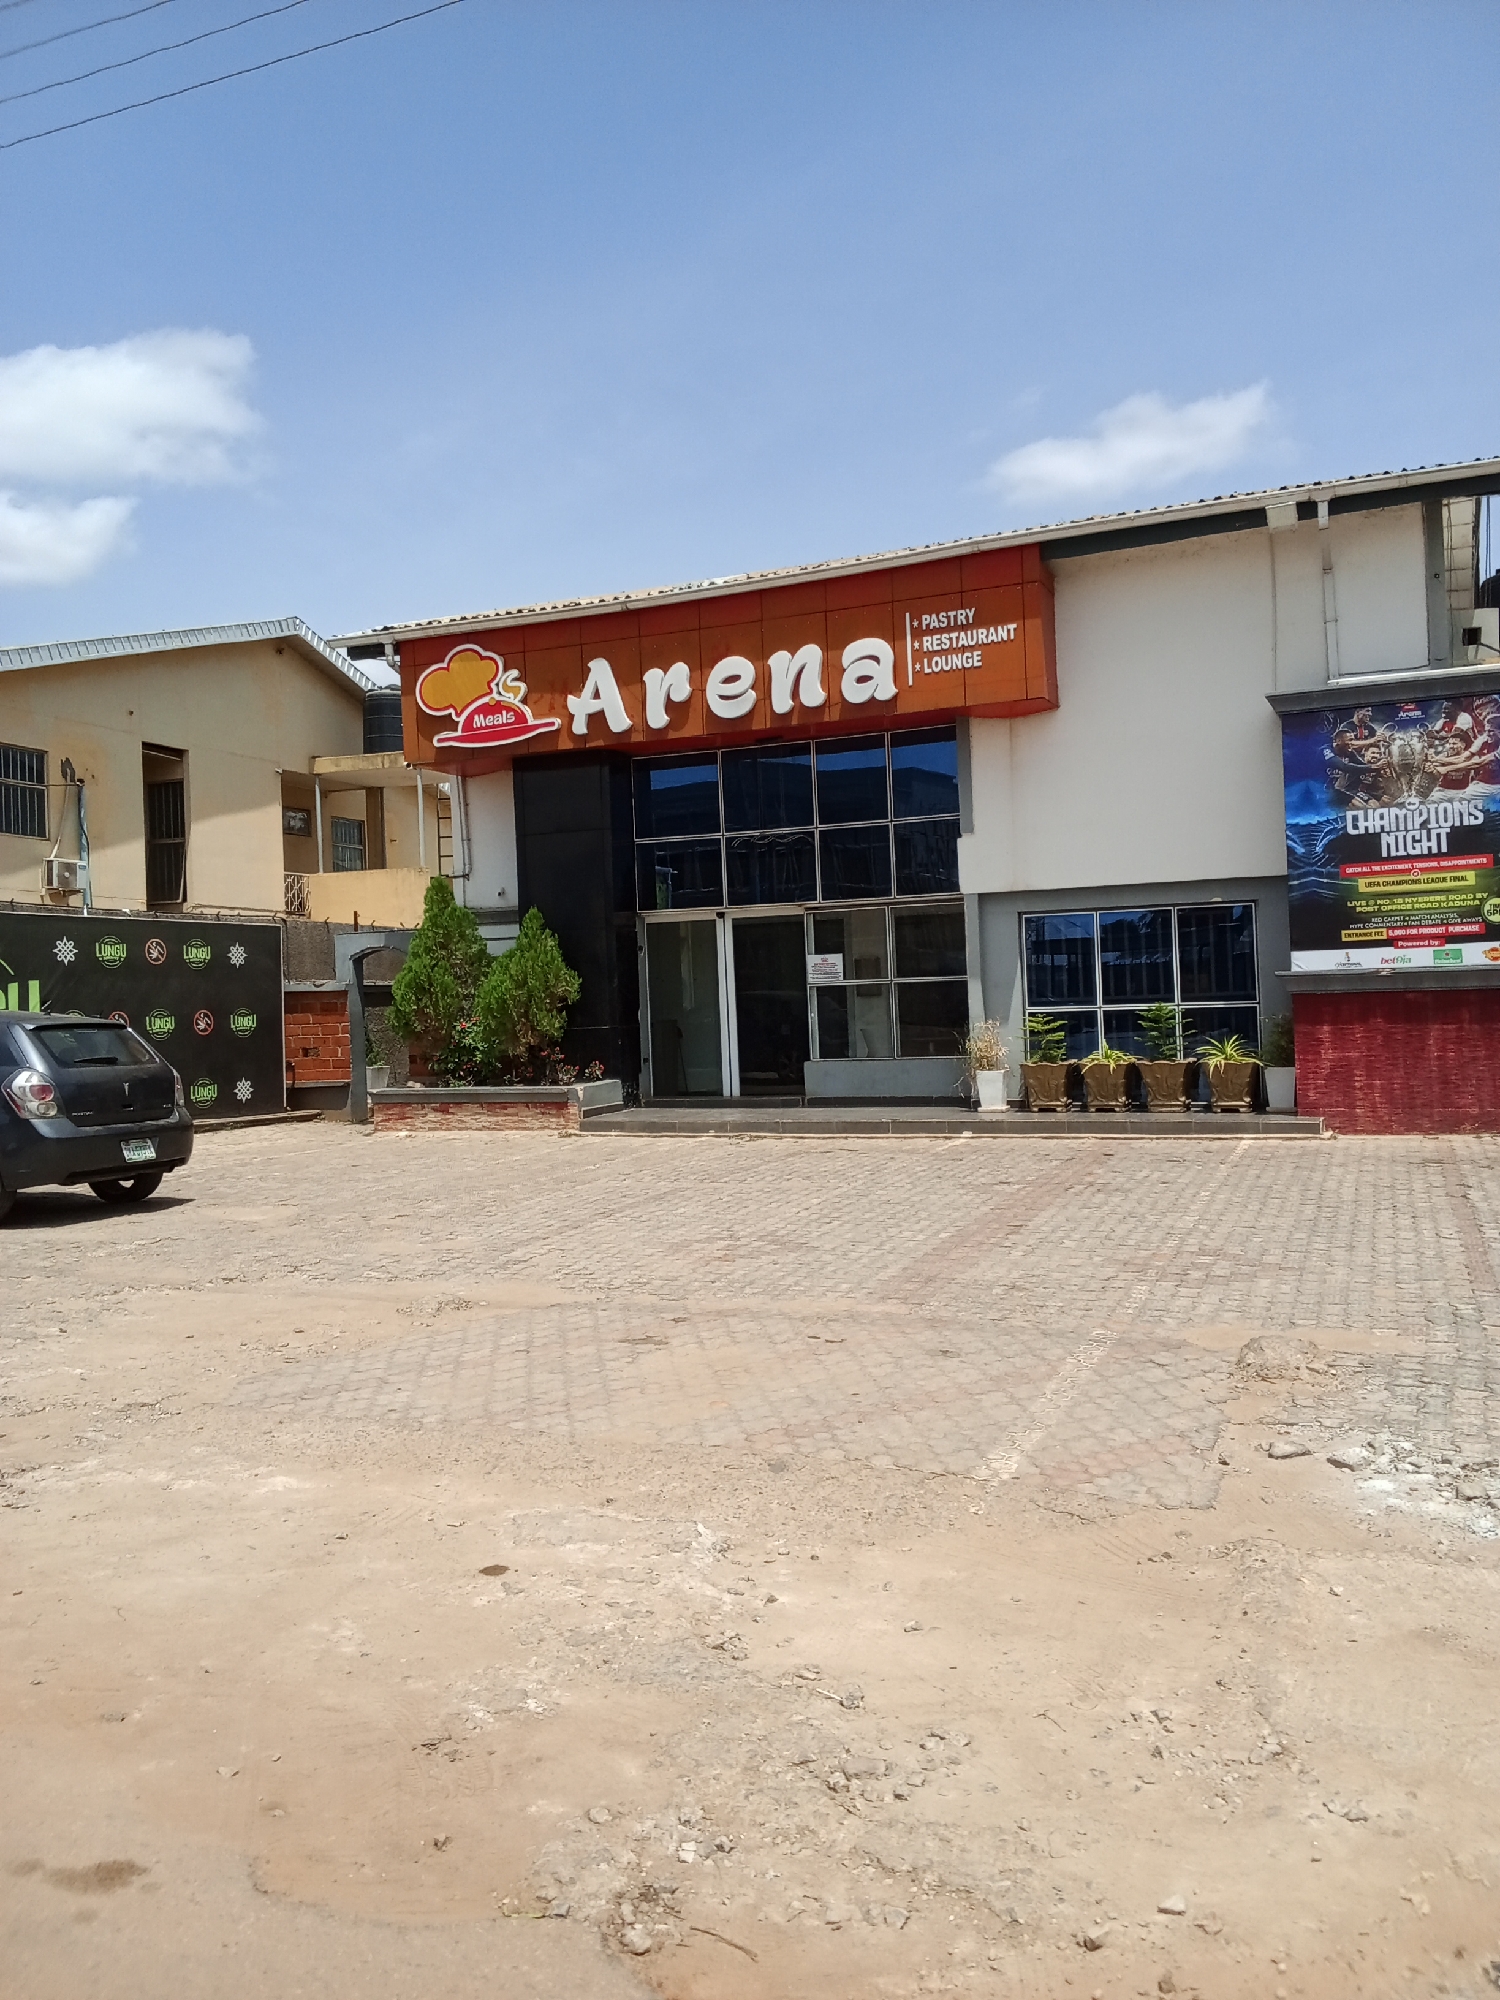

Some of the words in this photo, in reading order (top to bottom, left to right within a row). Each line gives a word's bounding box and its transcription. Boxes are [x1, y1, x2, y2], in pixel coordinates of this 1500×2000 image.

[922, 607, 976, 630] PASTRY
[922, 623, 1018, 652] RESTAURANT
[924, 651, 982, 674] LOUNGE
[567, 638, 898, 735] Arena
[473, 710, 516, 729] Meals
[1345, 800, 1484, 835] CHAMPIONS
[1381, 828, 1450, 857] NIGHT
[1364, 881, 1381, 889] UEFA
[1382, 878, 1422, 887] CHAMPIONS
[1422, 876, 1448, 885] LEAGUE
[1449, 875, 1469, 883] FINAL
[1448, 893, 1474, 901] ROAD
[1356, 905, 1379, 913] POST
[1381, 903, 1412, 912] OFFICE
[1413, 902, 1439, 910] ROAD
[1441, 899, 1481, 908] KADUNA
[1344, 931, 1373, 939] ENTRANCE
[1407, 927, 1418, 935] FOR
[1419, 926, 1446, 934] PRODUCT
[1448, 924, 1480, 933] PURCHASE
[95, 942, 127, 958] LUNGU
[1398, 940, 1429, 948] Powered
[183, 945, 211, 960] LUNGU
[145, 1016, 175, 1031] LUNGU
[230, 1014, 257, 1029] LUNGU
[190, 1084, 218, 1100] LUNGU
